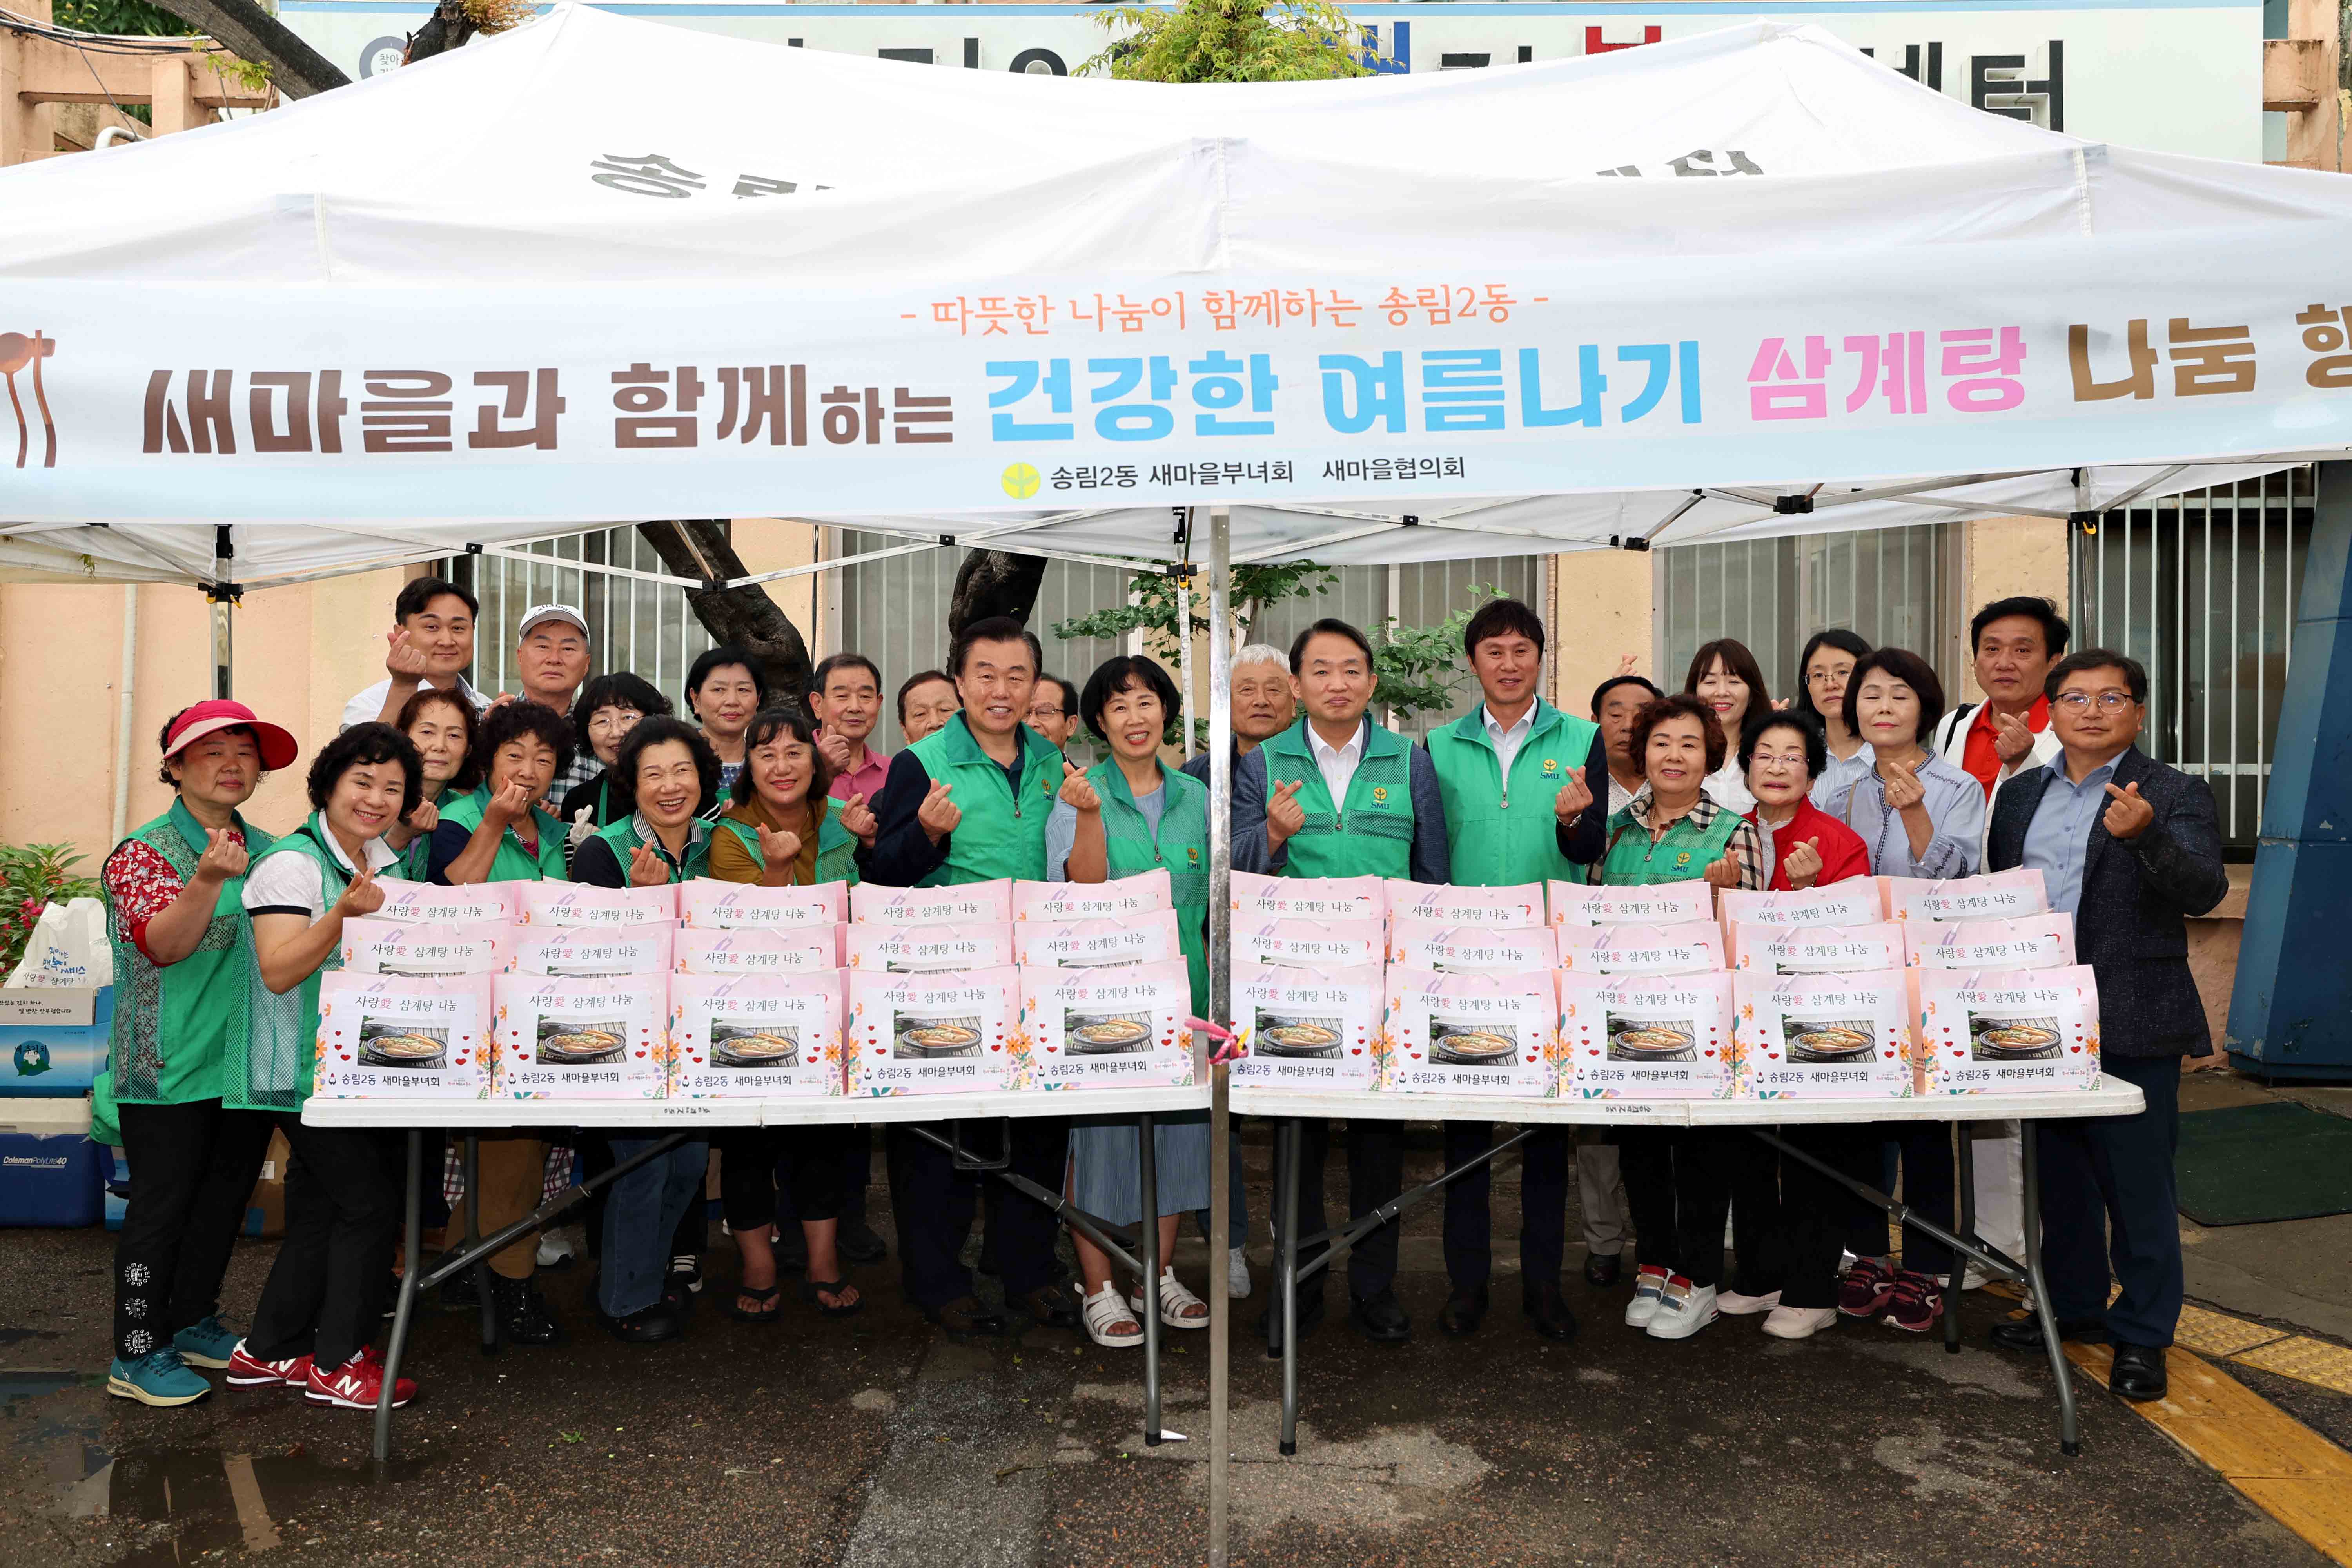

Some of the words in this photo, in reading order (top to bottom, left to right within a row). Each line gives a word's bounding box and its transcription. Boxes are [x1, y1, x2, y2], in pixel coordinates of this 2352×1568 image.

[932, 295, 1055, 335] 따뜻한
[1070, 292, 1185, 332] 나눔이
[1202, 289, 1362, 330] 함께하는
[1379, 285, 1517, 326] 송림2동
[143, 368, 566, 454] 새마을과
[612, 363, 953, 448] 함께하는
[986, 350, 1279, 441] 건강한
[1319, 341, 1702, 433] 여름나기
[1748, 326, 2026, 420] 삼계탕
[2068, 318, 2256, 402] 나눔
[1051, 465, 1138, 489] 송림2동
[1149, 461, 1292, 486] 새마을부녀회
[1323, 457, 1464, 481] 새마을협의회
[1044, 902, 1074, 913] 사랑愛
[1082, 902, 1111, 911] 삼계탕
[1119, 898, 1138, 909] 나눔
[1257, 899, 1286, 910] 사랑愛
[1294, 901, 1324, 912] 삼계탕
[1332, 902, 1353, 912] 나눔
[1582, 903, 1612, 913] 사랑愛
[1619, 903, 1650, 914] 삼계탕
[1657, 902, 1679, 913] 나눔
[1924, 899, 1951, 910] 사랑愛
[1957, 897, 1987, 909] 삼계탕
[1994, 894, 2016, 904] 나눔
[386, 906, 420, 917] 사랑愛
[428, 907, 457, 918] 삼계탕
[464, 907, 483, 917] 나눔
[549, 907, 582, 918] 사랑愛
[590, 910, 620, 921] 삼계탕
[626, 909, 644, 920] 나눔
[712, 907, 744, 918] 사랑愛
[750, 909, 780, 920] 삼계탕
[786, 909, 806, 919] 나눔
[884, 907, 915, 918] 사랑愛
[922, 905, 951, 917] 삼계탕
[959, 903, 978, 913] 나눔
[1412, 906, 1443, 918] 사랑愛
[1451, 909, 1483, 920] 삼계탕
[1490, 909, 1510, 920] 나눔
[1759, 912, 1786, 922] 사랑愛
[1791, 908, 1819, 920] 삼계탕
[1826, 904, 1847, 915] 나눔
[878, 943, 910, 954] 사랑愛
[918, 944, 948, 955] 삼계탕
[956, 942, 976, 953] 나눔
[1048, 941, 1079, 951] 사랑愛
[1088, 937, 1117, 950] 삼계탕
[1125, 933, 1145, 944] 나눔
[1252, 937, 1282, 949] 사랑愛
[1290, 943, 1320, 953] 삼계탕
[1329, 944, 1349, 954] 나눔
[371, 944, 407, 956] 사랑愛
[415, 947, 448, 957] 삼계탕
[455, 946, 473, 956] 나눔
[539, 948, 573, 959] 사랑愛
[581, 948, 612, 959] 삼계탕
[619, 946, 638, 956] 나눔
[1425, 944, 1455, 957] 사랑愛
[1462, 949, 1494, 960] 삼계탕
[1502, 949, 1523, 960] 나눔
[1591, 951, 1621, 963] 사랑愛
[1629, 951, 1660, 962] 삼계탕
[1668, 949, 1690, 960] 나눔
[1768, 944, 1797, 956] 사랑愛
[1804, 946, 1837, 956] 삼계탕
[1845, 944, 1868, 955] 나눔
[1936, 947, 1966, 959] 사랑愛
[1973, 945, 2007, 958] 삼계탕
[2014, 942, 2038, 953] 나눔
[705, 953, 738, 964] 사랑愛
[746, 954, 777, 965] 삼계탕
[784, 953, 803, 964] 나눔
[884, 991, 916, 1002] 사랑愛
[925, 991, 957, 1003] 삼계탕
[965, 989, 985, 1000] 나눔
[1055, 988, 1087, 1000] 사랑愛
[1096, 987, 1127, 999] 삼계탕
[1136, 985, 1156, 996] 나눔
[1246, 987, 1278, 1000] 사랑愛
[1286, 990, 1318, 1002] 삼계탕
[1327, 991, 1348, 1002] 나눔
[1596, 991, 1627, 1004] 사랑愛
[1634, 994, 1666, 1005] 삼계탕
[1675, 993, 1697, 1004] 나눔
[1772, 994, 1803, 1006] 사랑愛
[1812, 994, 1845, 1005] 삼계탕
[1854, 993, 1878, 1004] 나눔
[1956, 991, 1988, 1003] 사랑愛
[1994, 991, 2026, 1003] 삼계탕
[2034, 990, 2059, 1001] 나눔
[355, 996, 392, 1009] 사랑愛
[400, 1000, 432, 1012] 삼계탕
[439, 1000, 457, 1012] 나눔
[529, 996, 564, 1007] 사랑愛
[573, 996, 606, 1008] 삼계탕
[613, 995, 633, 1005] 나눔
[703, 999, 737, 1010] 사랑愛
[746, 1000, 777, 1011] 삼계탕
[785, 999, 806, 1010] 나눔
[1421, 995, 1450, 1009] 사랑愛
[1459, 999, 1490, 1010] 삼계탕
[1499, 999, 1521, 1010] 나눔
[878, 1068, 912, 1079] 송림2동
[918, 1065, 975, 1078] 새마을부녀회
[1051, 1064, 1084, 1076] 송림2동
[1090, 1061, 1146, 1073] 새마을부녀회
[1236, 1062, 1271, 1076] 송림2동
[1277, 1065, 1334, 1077] 새마을부녀회
[1590, 1069, 1625, 1080] 송림2동
[1631, 1070, 1688, 1081] 새마을부녀회
[1956, 1069, 1991, 1081] 송림2동
[1996, 1067, 2054, 1079] 새마을부녀회
[342, 1074, 376, 1085] 송림2동
[382, 1076, 439, 1087] 새마을부녀회
[521, 1073, 556, 1083] 송림2동
[561, 1072, 619, 1083] 새마을부녀회
[695, 1076, 728, 1087] 송림2동
[735, 1075, 791, 1086] 새마을부녀회
[1412, 1073, 1446, 1084] 송림2동
[1452, 1074, 1509, 1085] 새마을부녀회
[1769, 1072, 1804, 1083] 송림2동
[1810, 1071, 1868, 1083] 새마을부녀회
[334, 1375, 361, 1396] N
